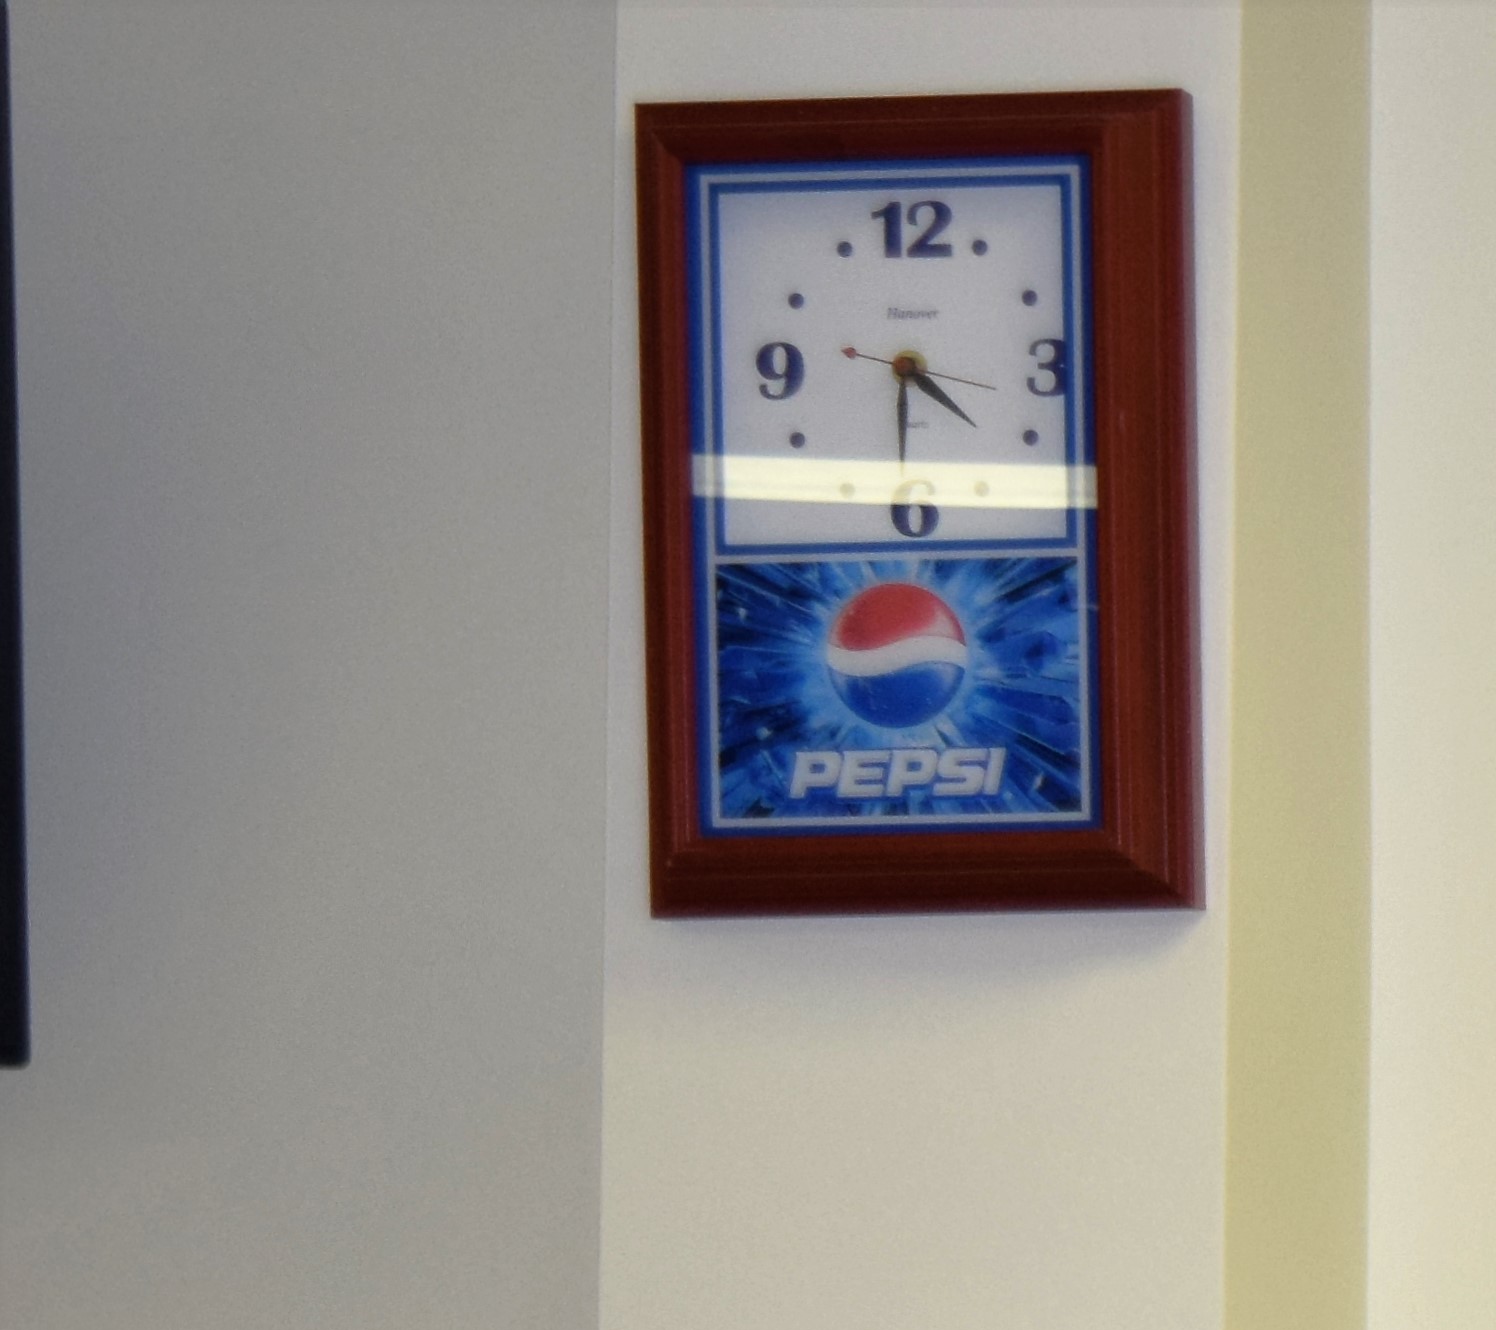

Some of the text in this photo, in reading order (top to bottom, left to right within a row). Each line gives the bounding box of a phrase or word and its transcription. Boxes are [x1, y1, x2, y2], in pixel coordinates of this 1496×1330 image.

[871, 200, 953, 259] 12
[756, 341, 804, 400] 9
[1026, 338, 1065, 396] 3
[890, 479, 939, 538] 6
[788, 745, 1006, 799] PEPSI
